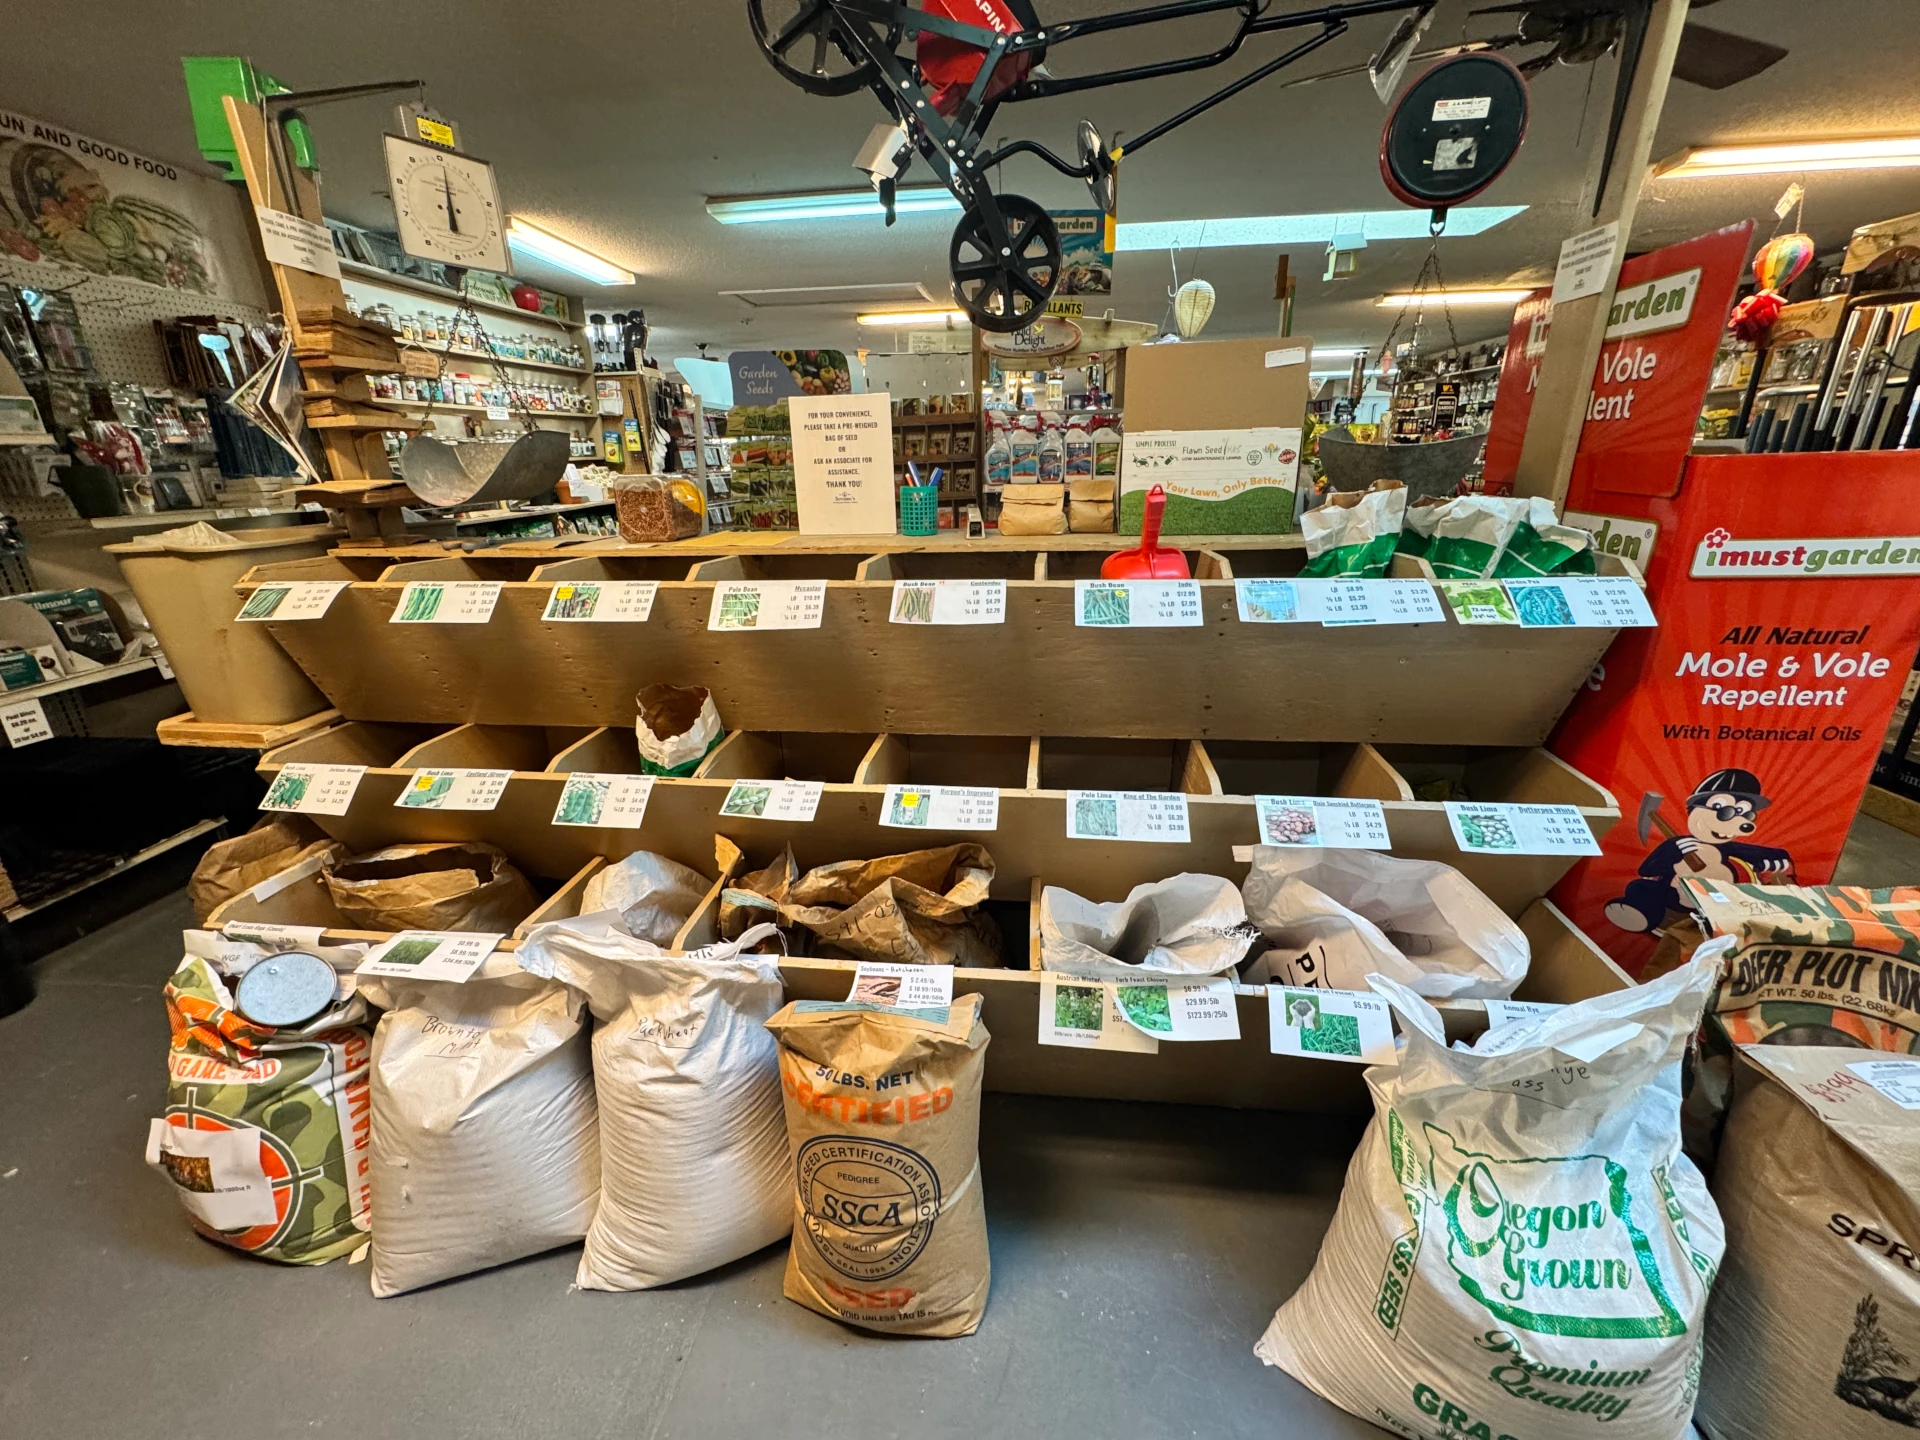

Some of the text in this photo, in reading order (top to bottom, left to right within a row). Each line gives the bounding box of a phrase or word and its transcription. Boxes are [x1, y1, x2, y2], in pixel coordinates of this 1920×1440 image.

[33, 124, 71, 147] AND
[77, 139, 129, 166] GOOD
[134, 156, 177, 180] FOOD
[1024, 300, 1083, 315] RLLANTS
[1014, 334, 1046, 348] Delight
[739, 364, 779, 379] Garden
[1604, 346, 1657, 384] Vole
[746, 379, 774, 395] Seeds
[835, 410, 872, 418] CONVENIENCE,
[804, 423, 823, 431] PLEASE
[1205, 445, 1222, 454] Seed
[1165, 476, 1287, 498] Your Lawn, Only Better!
[1719, 625, 1870, 645] All Natural
[1674, 652, 1891, 678] Mole & Vole
[1701, 683, 1848, 712] Repellent
[1661, 723, 1863, 741] With Botanical Oils
[221, 954, 241, 962] WGF
[1792, 951, 1875, 992] PLOT
[1185, 997, 1220, 1006] $29.99/5lb
[1777, 987, 1799, 998] WT.
[1802, 988, 1816, 999] 50
[1817, 989, 1839, 1002] lbs.
[1353, 1001, 1381, 1010] $5.99/lb
[1503, 1003, 1540, 1014] Annual Rye
[1187, 1011, 1228, 1020] $123.99/25lb
[176, 1058, 227, 1080] GAME
[816, 1065, 914, 1091] 50 LBS. NET
[781, 1070, 954, 1126] CERTIFIED
[803, 1147, 921, 1182] SEED CERTIFICATION
[837, 1171, 880, 1185] PEDIGREE
[821, 1193, 904, 1228] SSCA
[1444, 1160, 1607, 1258] Oregon
[843, 1242, 878, 1254] QUALITY
[837, 1259, 861, 1275] SEAL
[1500, 1231, 1633, 1301] Grown
[1377, 1270, 1404, 1330] SEED
[841, 1309, 860, 1321] VOID
[898, 1312, 915, 1320] TAG
[917, 1310, 926, 1318] IS
[1473, 1330, 1652, 1388] Premium
[1488, 1365, 1632, 1422] Quality
